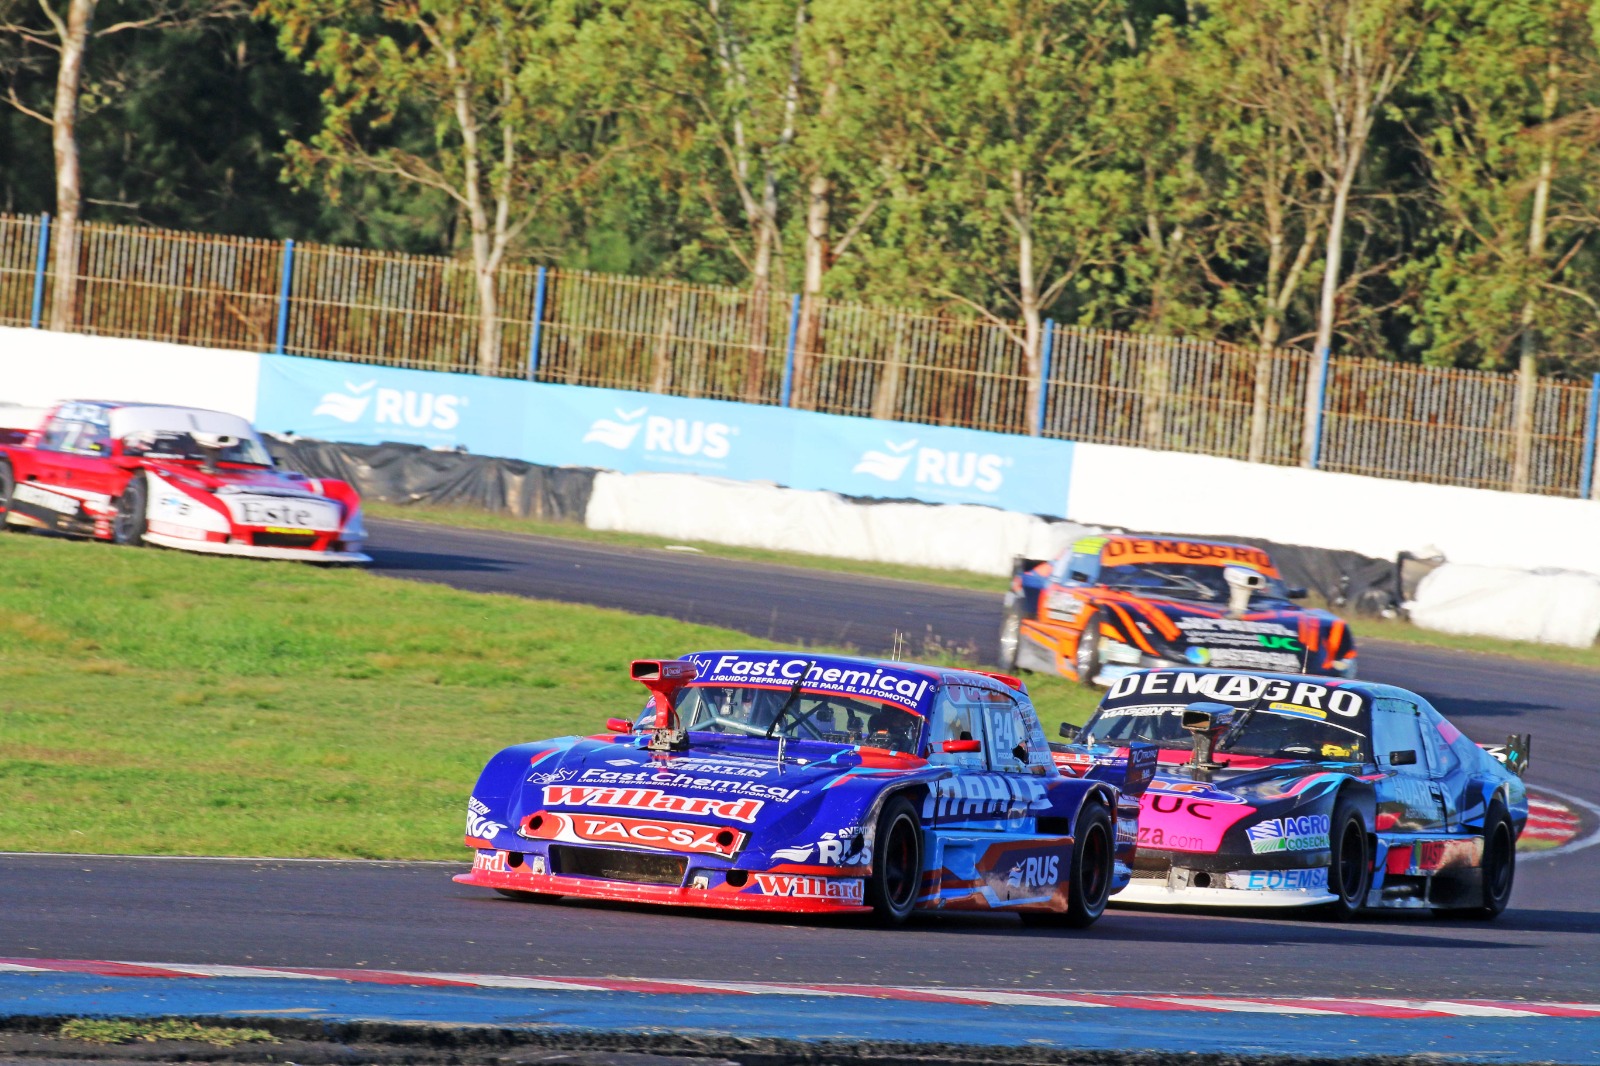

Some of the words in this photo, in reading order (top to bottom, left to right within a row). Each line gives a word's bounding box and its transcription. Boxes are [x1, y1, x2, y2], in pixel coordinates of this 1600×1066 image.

[375, 388, 459, 430] RUS
[645, 415, 731, 459] RUS
[914, 447, 1003, 493] RUS
[710, 675, 748, 683] LIQUIDO
[820, 682, 845, 691] PARA
[846, 685, 857, 693] EL
[858, 687, 918, 709] AUTOMOTOR
[1107, 671, 1363, 718] DEMAGRO
[994, 711, 1014, 750] 24
[542, 785, 765, 824] Willard
[729, 790, 790, 804] AUTOMOTOR
[584, 820, 718, 850] TACSA
[1285, 815, 1331, 837] AGRO
[755, 873, 865, 900] Willard
[1025, 855, 1060, 888] RUS
